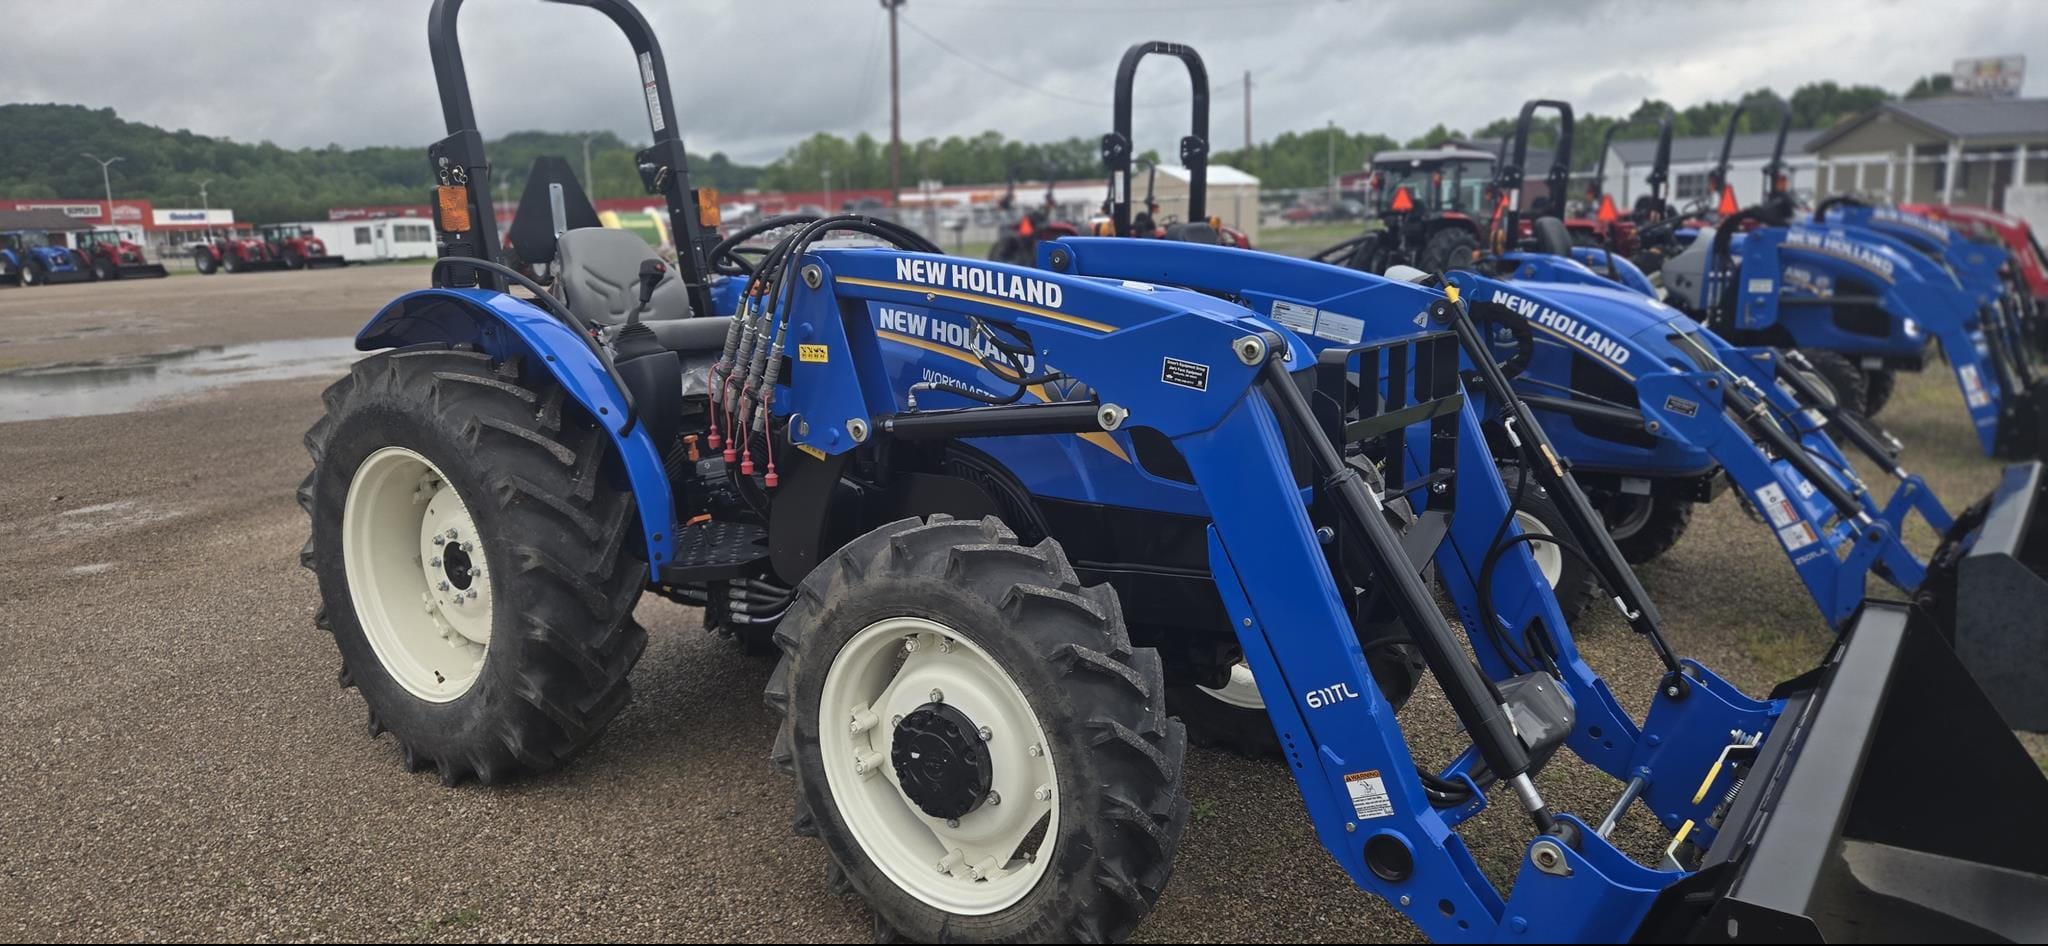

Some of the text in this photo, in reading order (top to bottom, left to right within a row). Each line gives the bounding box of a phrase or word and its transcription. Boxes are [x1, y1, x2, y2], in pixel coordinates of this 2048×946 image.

[896, 258, 1062, 309] NEW HOLLAND
[880, 307, 928, 337] NEW
[1492, 290, 1630, 365] NEW HOLLAND
[1306, 683, 1358, 708] 611TL
